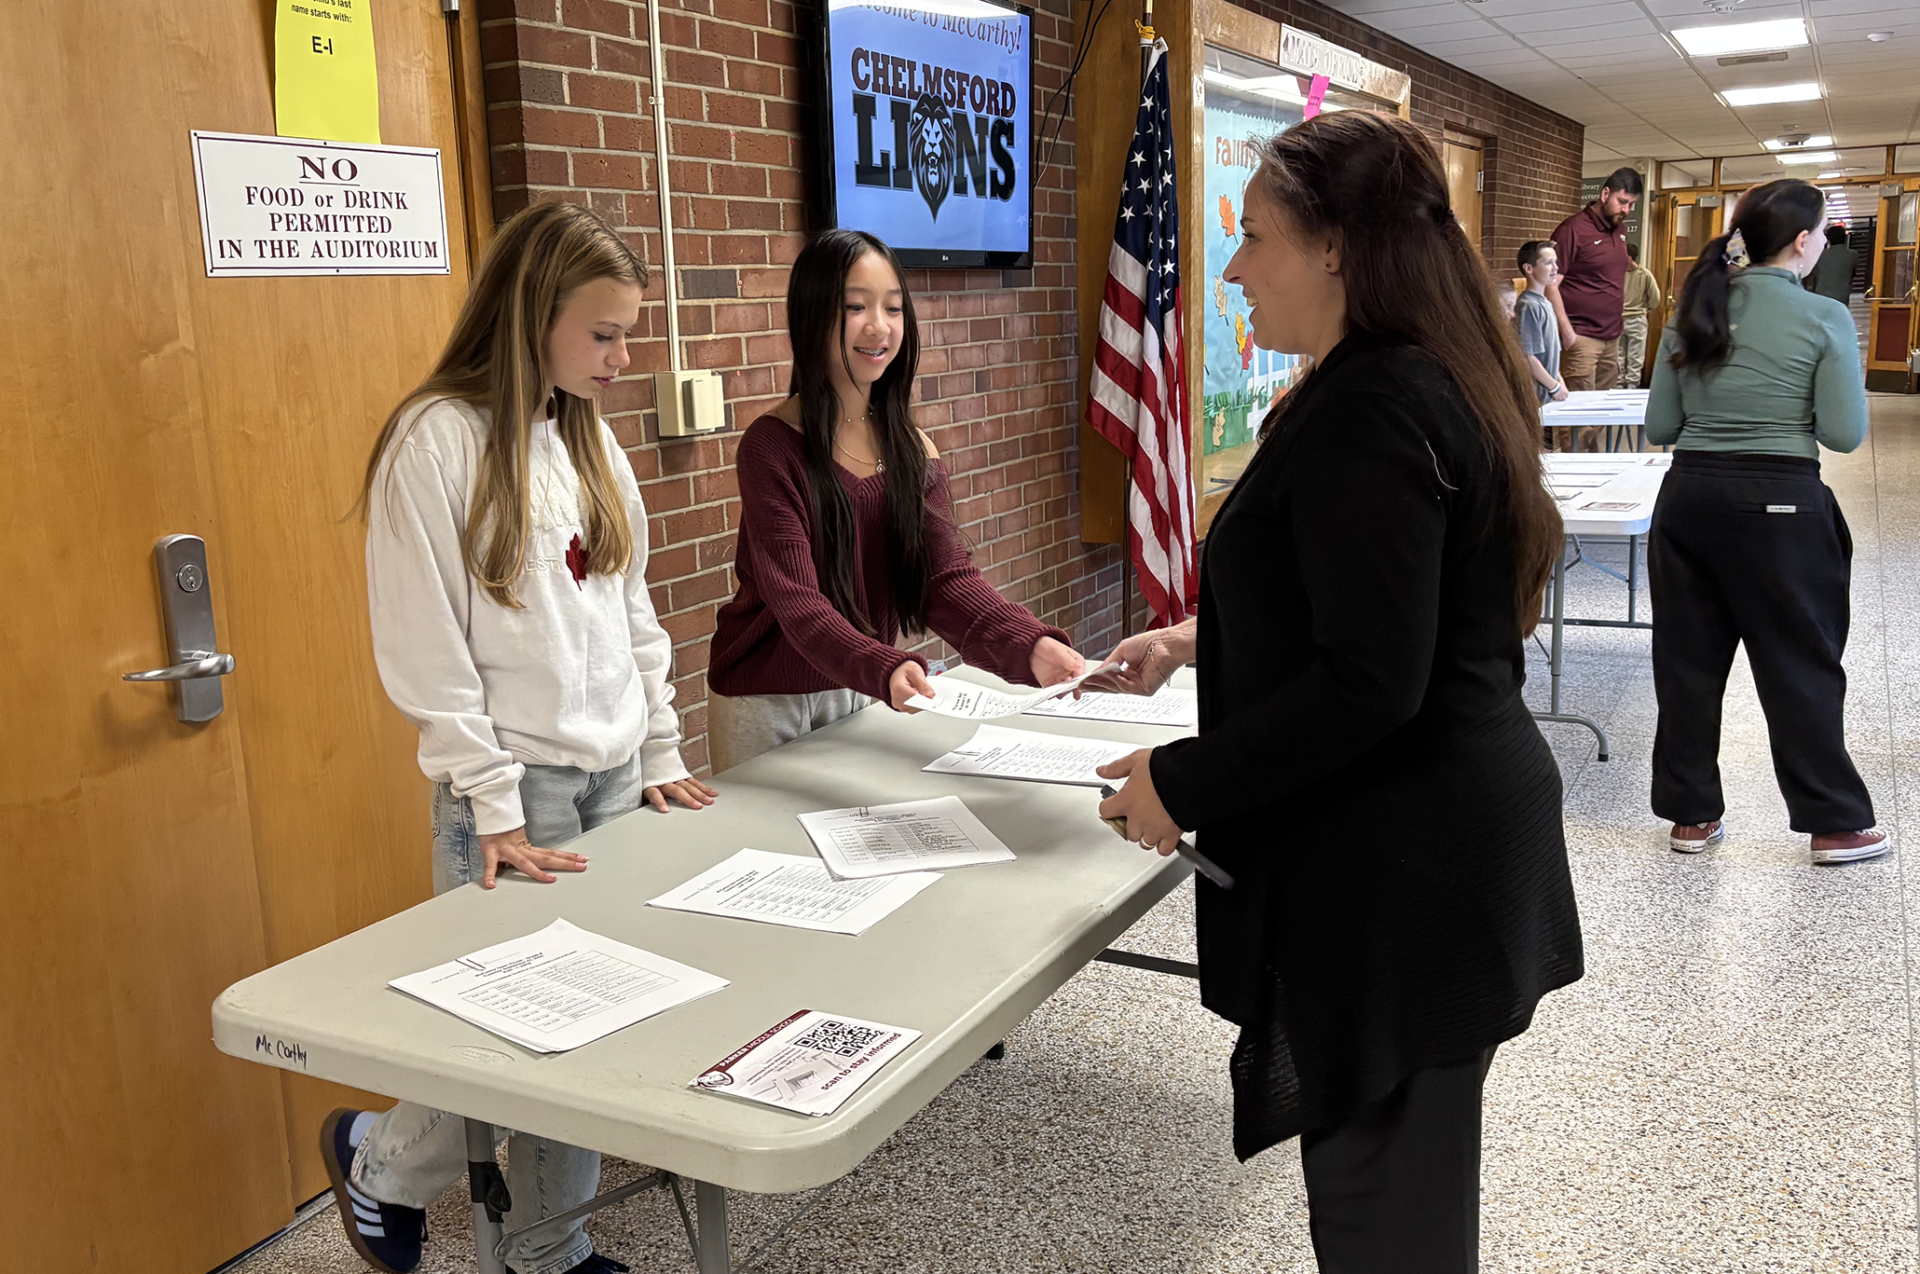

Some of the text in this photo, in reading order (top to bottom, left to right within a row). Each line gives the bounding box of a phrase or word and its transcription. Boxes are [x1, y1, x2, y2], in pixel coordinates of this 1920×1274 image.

[291, 4, 352, 23] name starts with:
[922, 11, 939, 28] to
[942, 14, 1022, 54] McCarthy!
[312, 35, 333, 55] E-I
[851, 47, 1017, 118] CHELMSFORD
[852, 90, 1017, 202] LINS
[297, 155, 359, 182] NO
[244, 186, 409, 210] FOOD or DRINK
[269, 212, 392, 234] PERMITTED
[218, 239, 439, 259] IN THE AUDITORIUM
[256, 1034, 274, 1056] Mc
[821, 1032, 903, 1091] scan to stay informed
